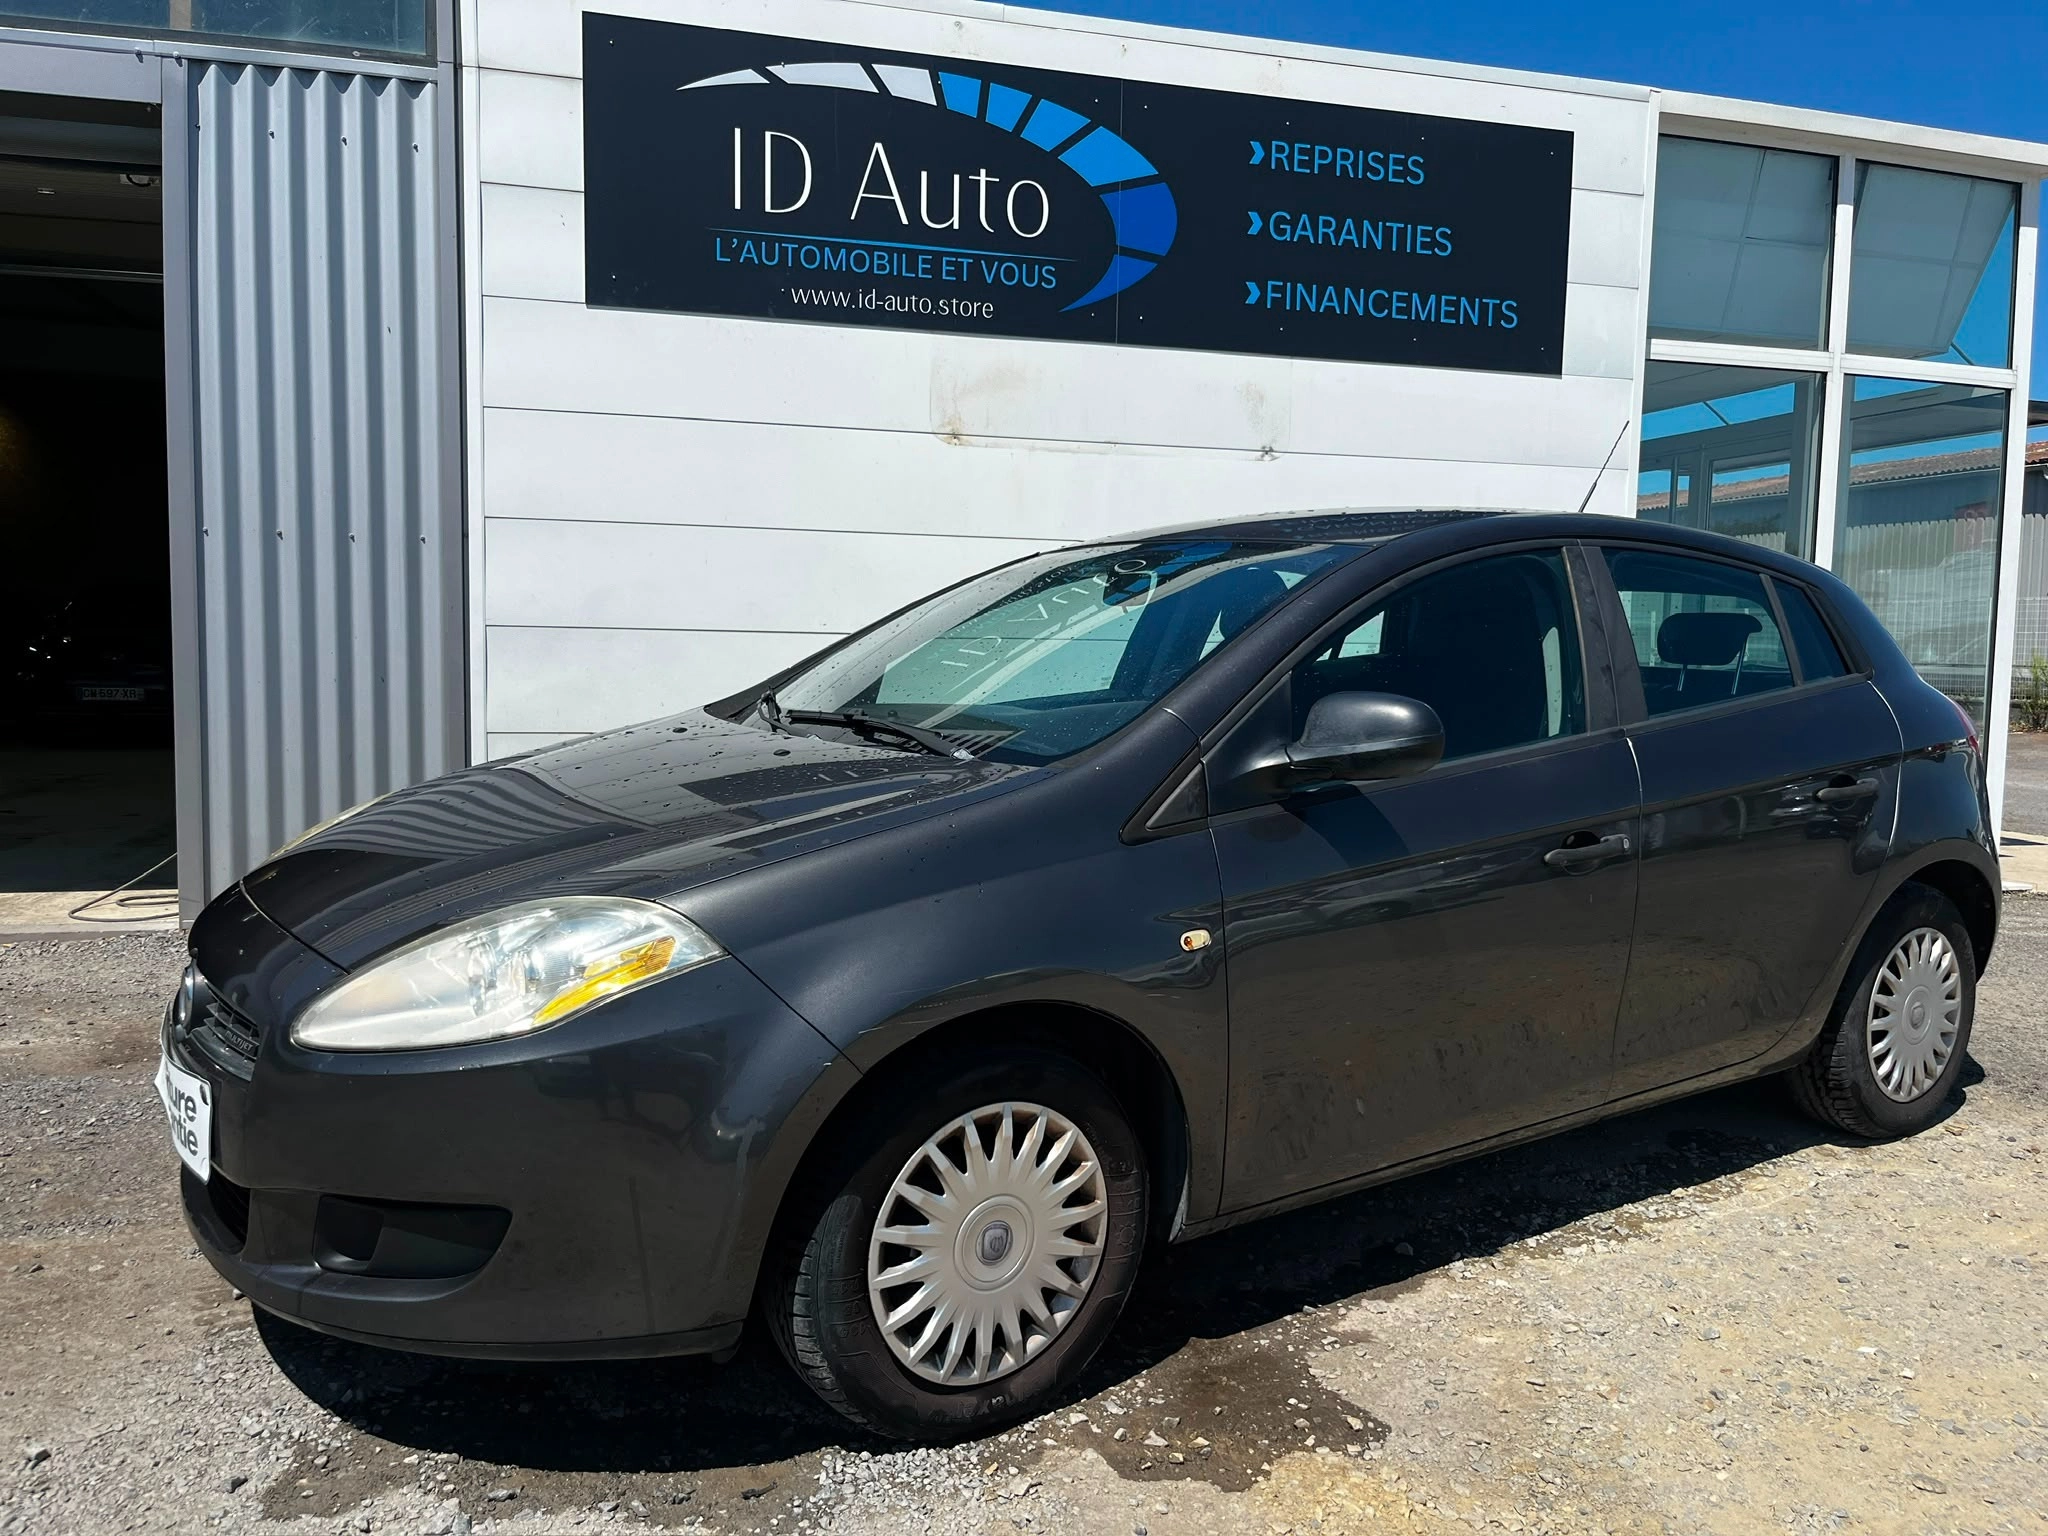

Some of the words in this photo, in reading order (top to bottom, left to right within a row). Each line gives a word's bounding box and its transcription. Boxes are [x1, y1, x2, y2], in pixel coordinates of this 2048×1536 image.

[734, 127, 812, 213] ID
[851, 142, 1050, 238] Auto
[1271, 140, 1425, 185] REPRISES
[1268, 211, 1452, 257] GARANTIES
[716, 237, 932, 279] L’AUTOMOBILE
[943, 256, 974, 282] ET
[980, 259, 1057, 288] VOUS
[792, 287, 994, 319] www.id-auto.store
[1266, 280, 1518, 329] FINANCEMENTS
